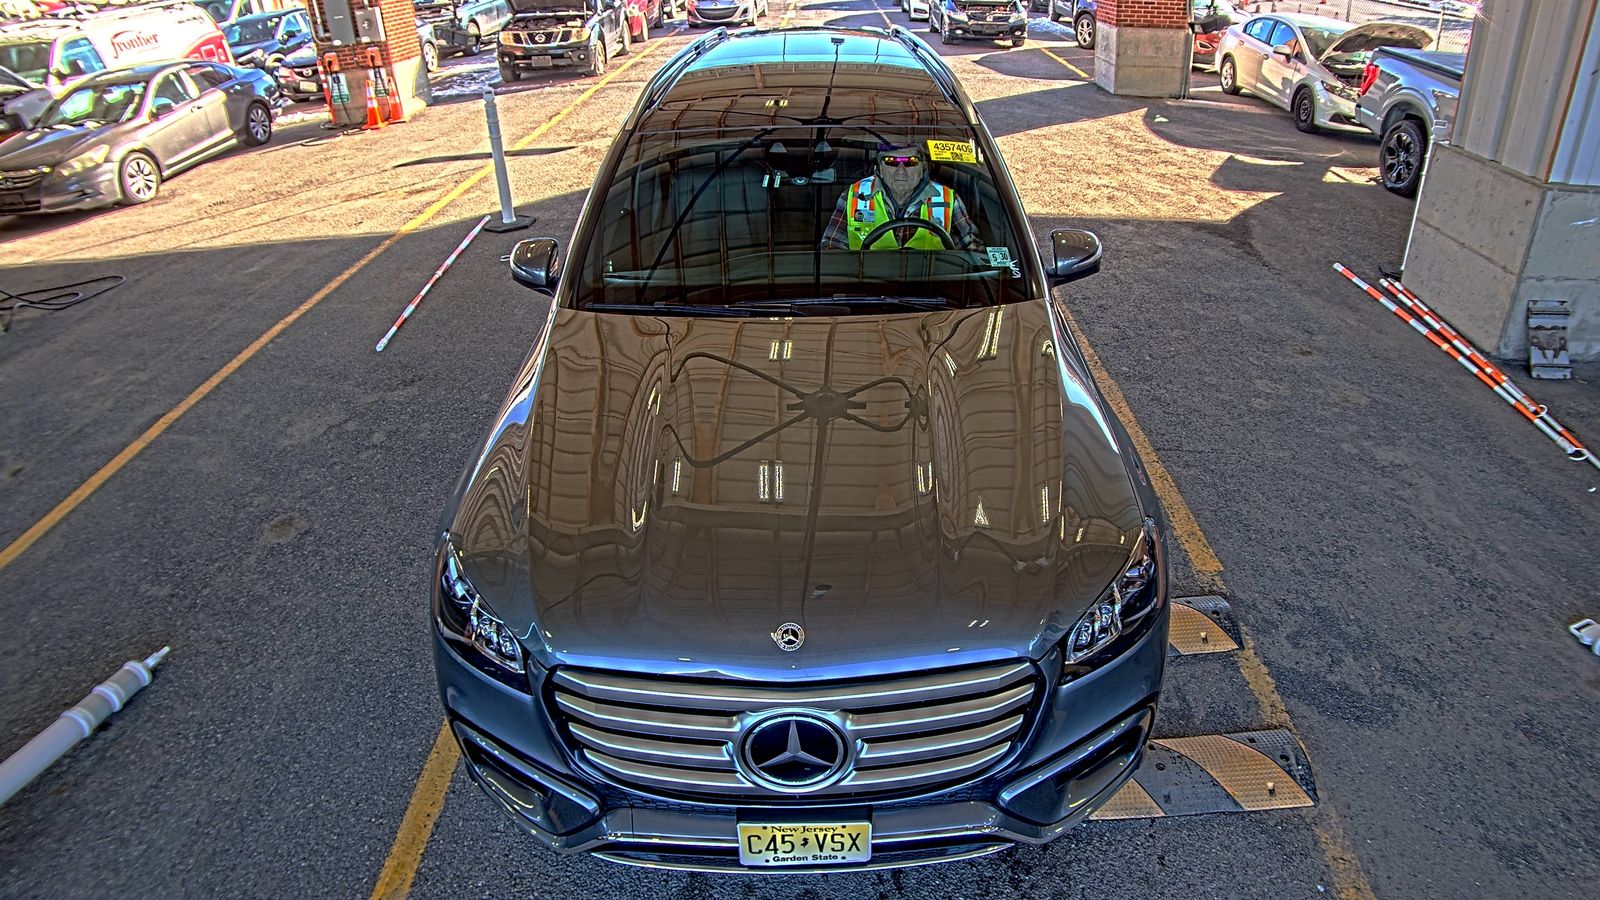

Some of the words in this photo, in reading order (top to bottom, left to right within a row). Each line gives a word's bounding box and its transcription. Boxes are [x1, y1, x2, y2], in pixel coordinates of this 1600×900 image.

[110, 30, 159, 59] frontier
[992, 253, 998, 262] 5
[801, 825, 838, 834] Jersey
[747, 834, 796, 854] C45
[814, 833, 862, 853] VSX
[773, 855, 808, 863] Garden
